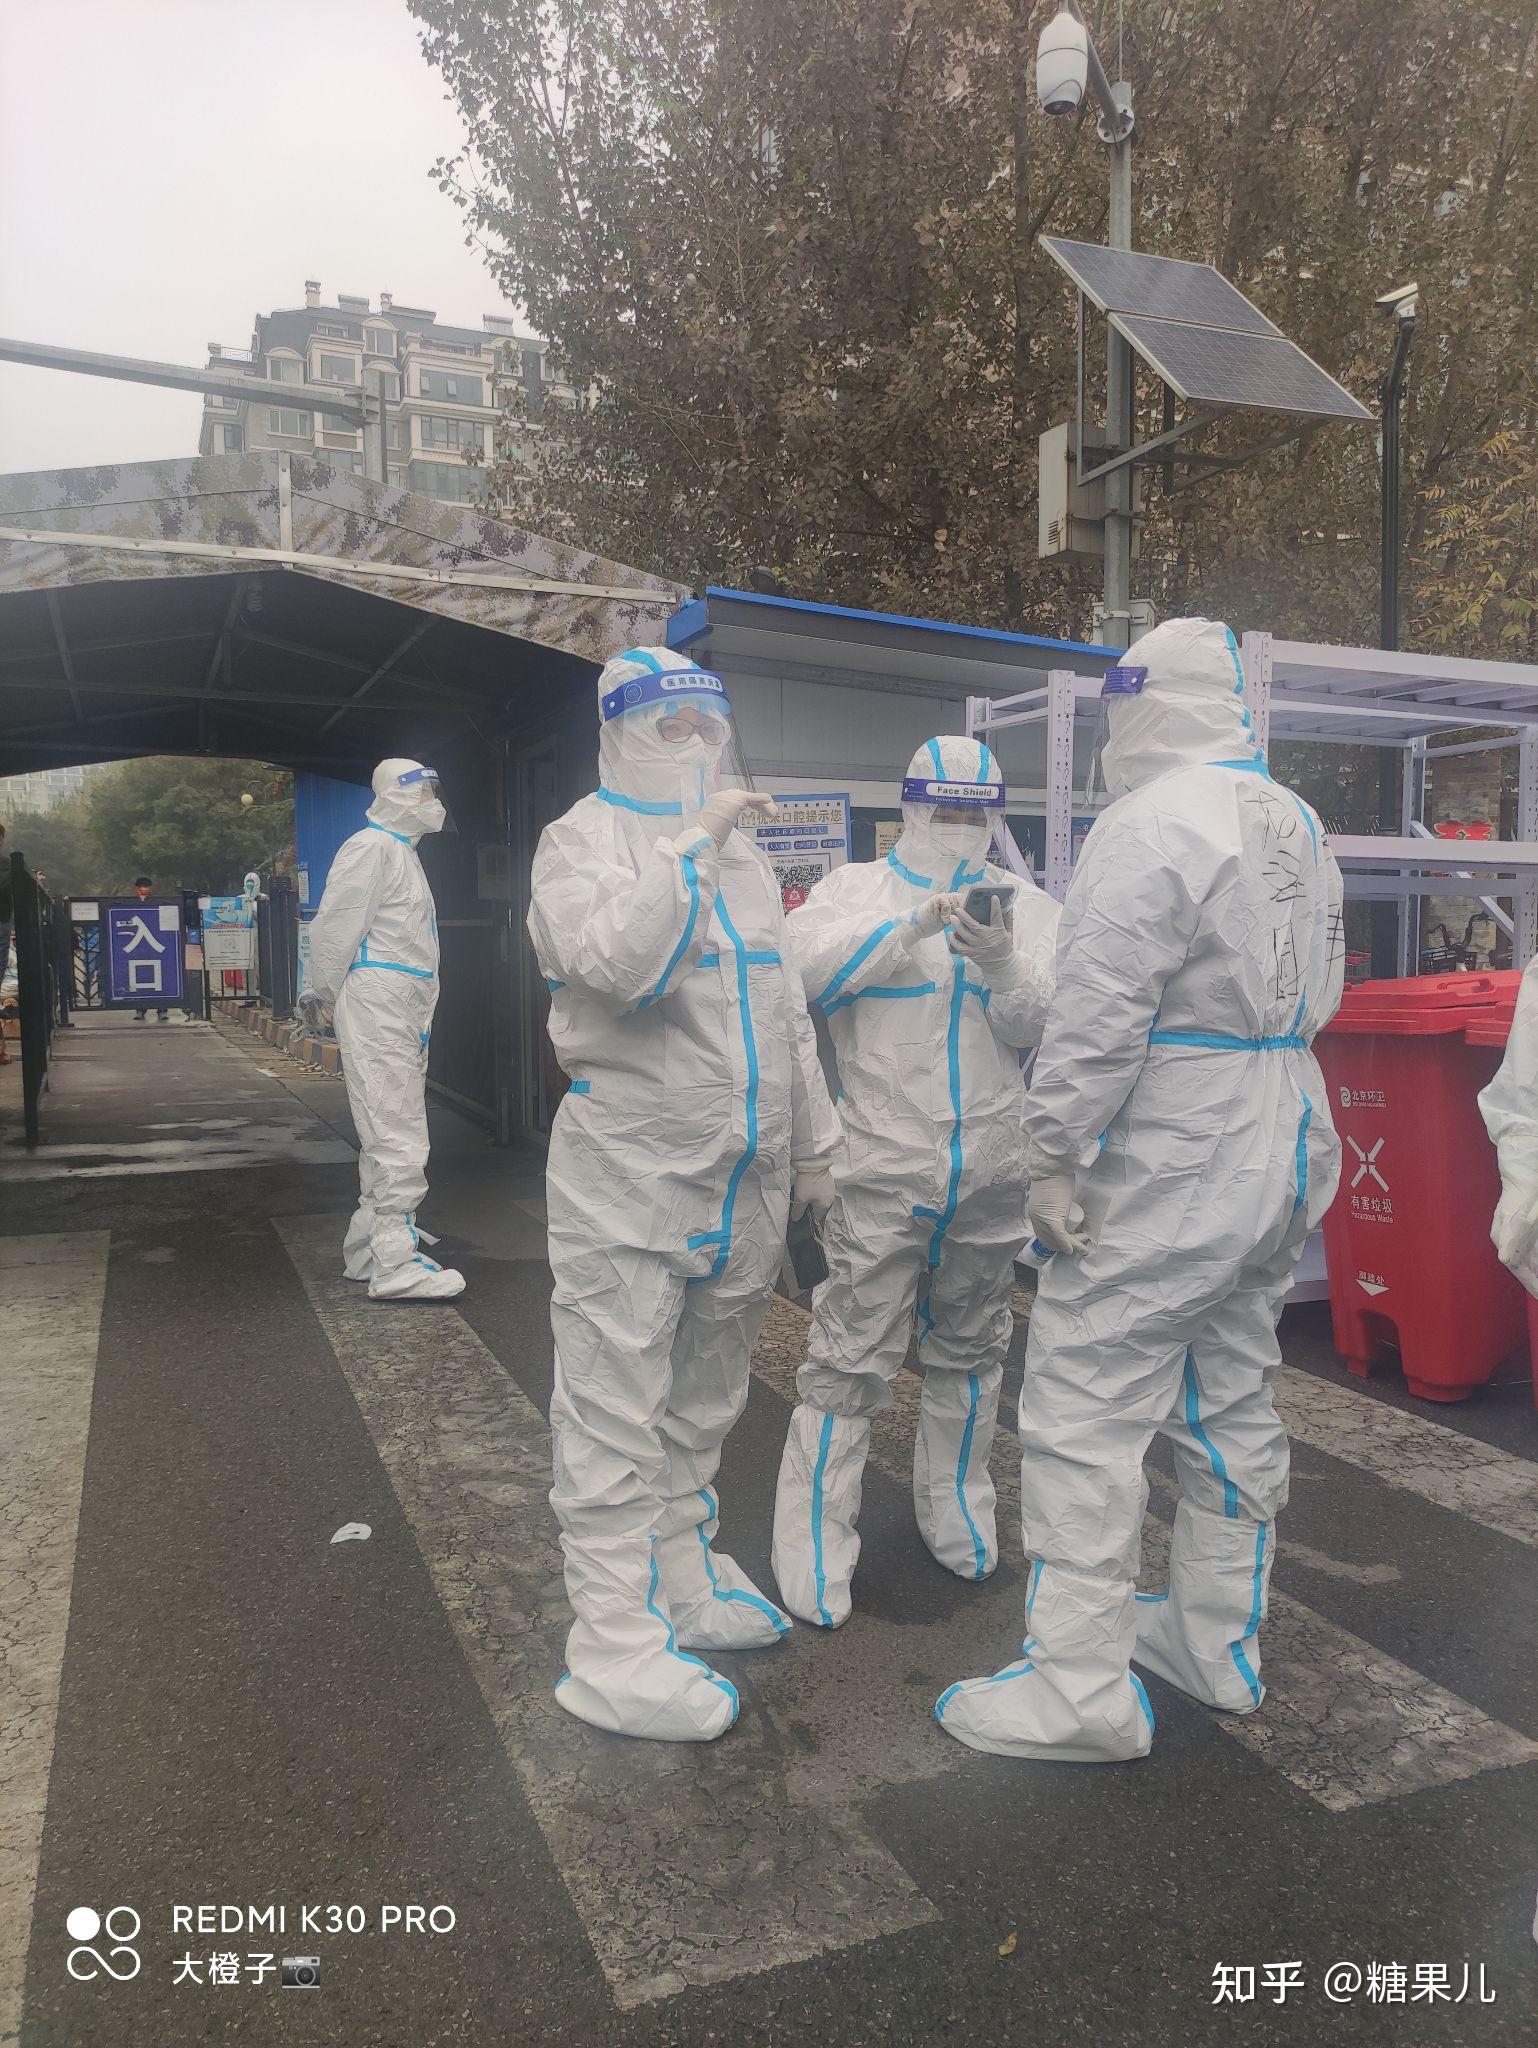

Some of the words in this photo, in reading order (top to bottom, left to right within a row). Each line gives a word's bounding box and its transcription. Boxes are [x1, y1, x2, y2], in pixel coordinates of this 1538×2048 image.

[937, 786, 960, 795] Face
[963, 787, 992, 797] Shield
[122, 915, 166, 992] 入口
[1352, 1090, 1386, 1102] 北京环卫
[1351, 1194, 1393, 1213] 有害垃圾
[1358, 1270, 1385, 1286] 脚踏处
